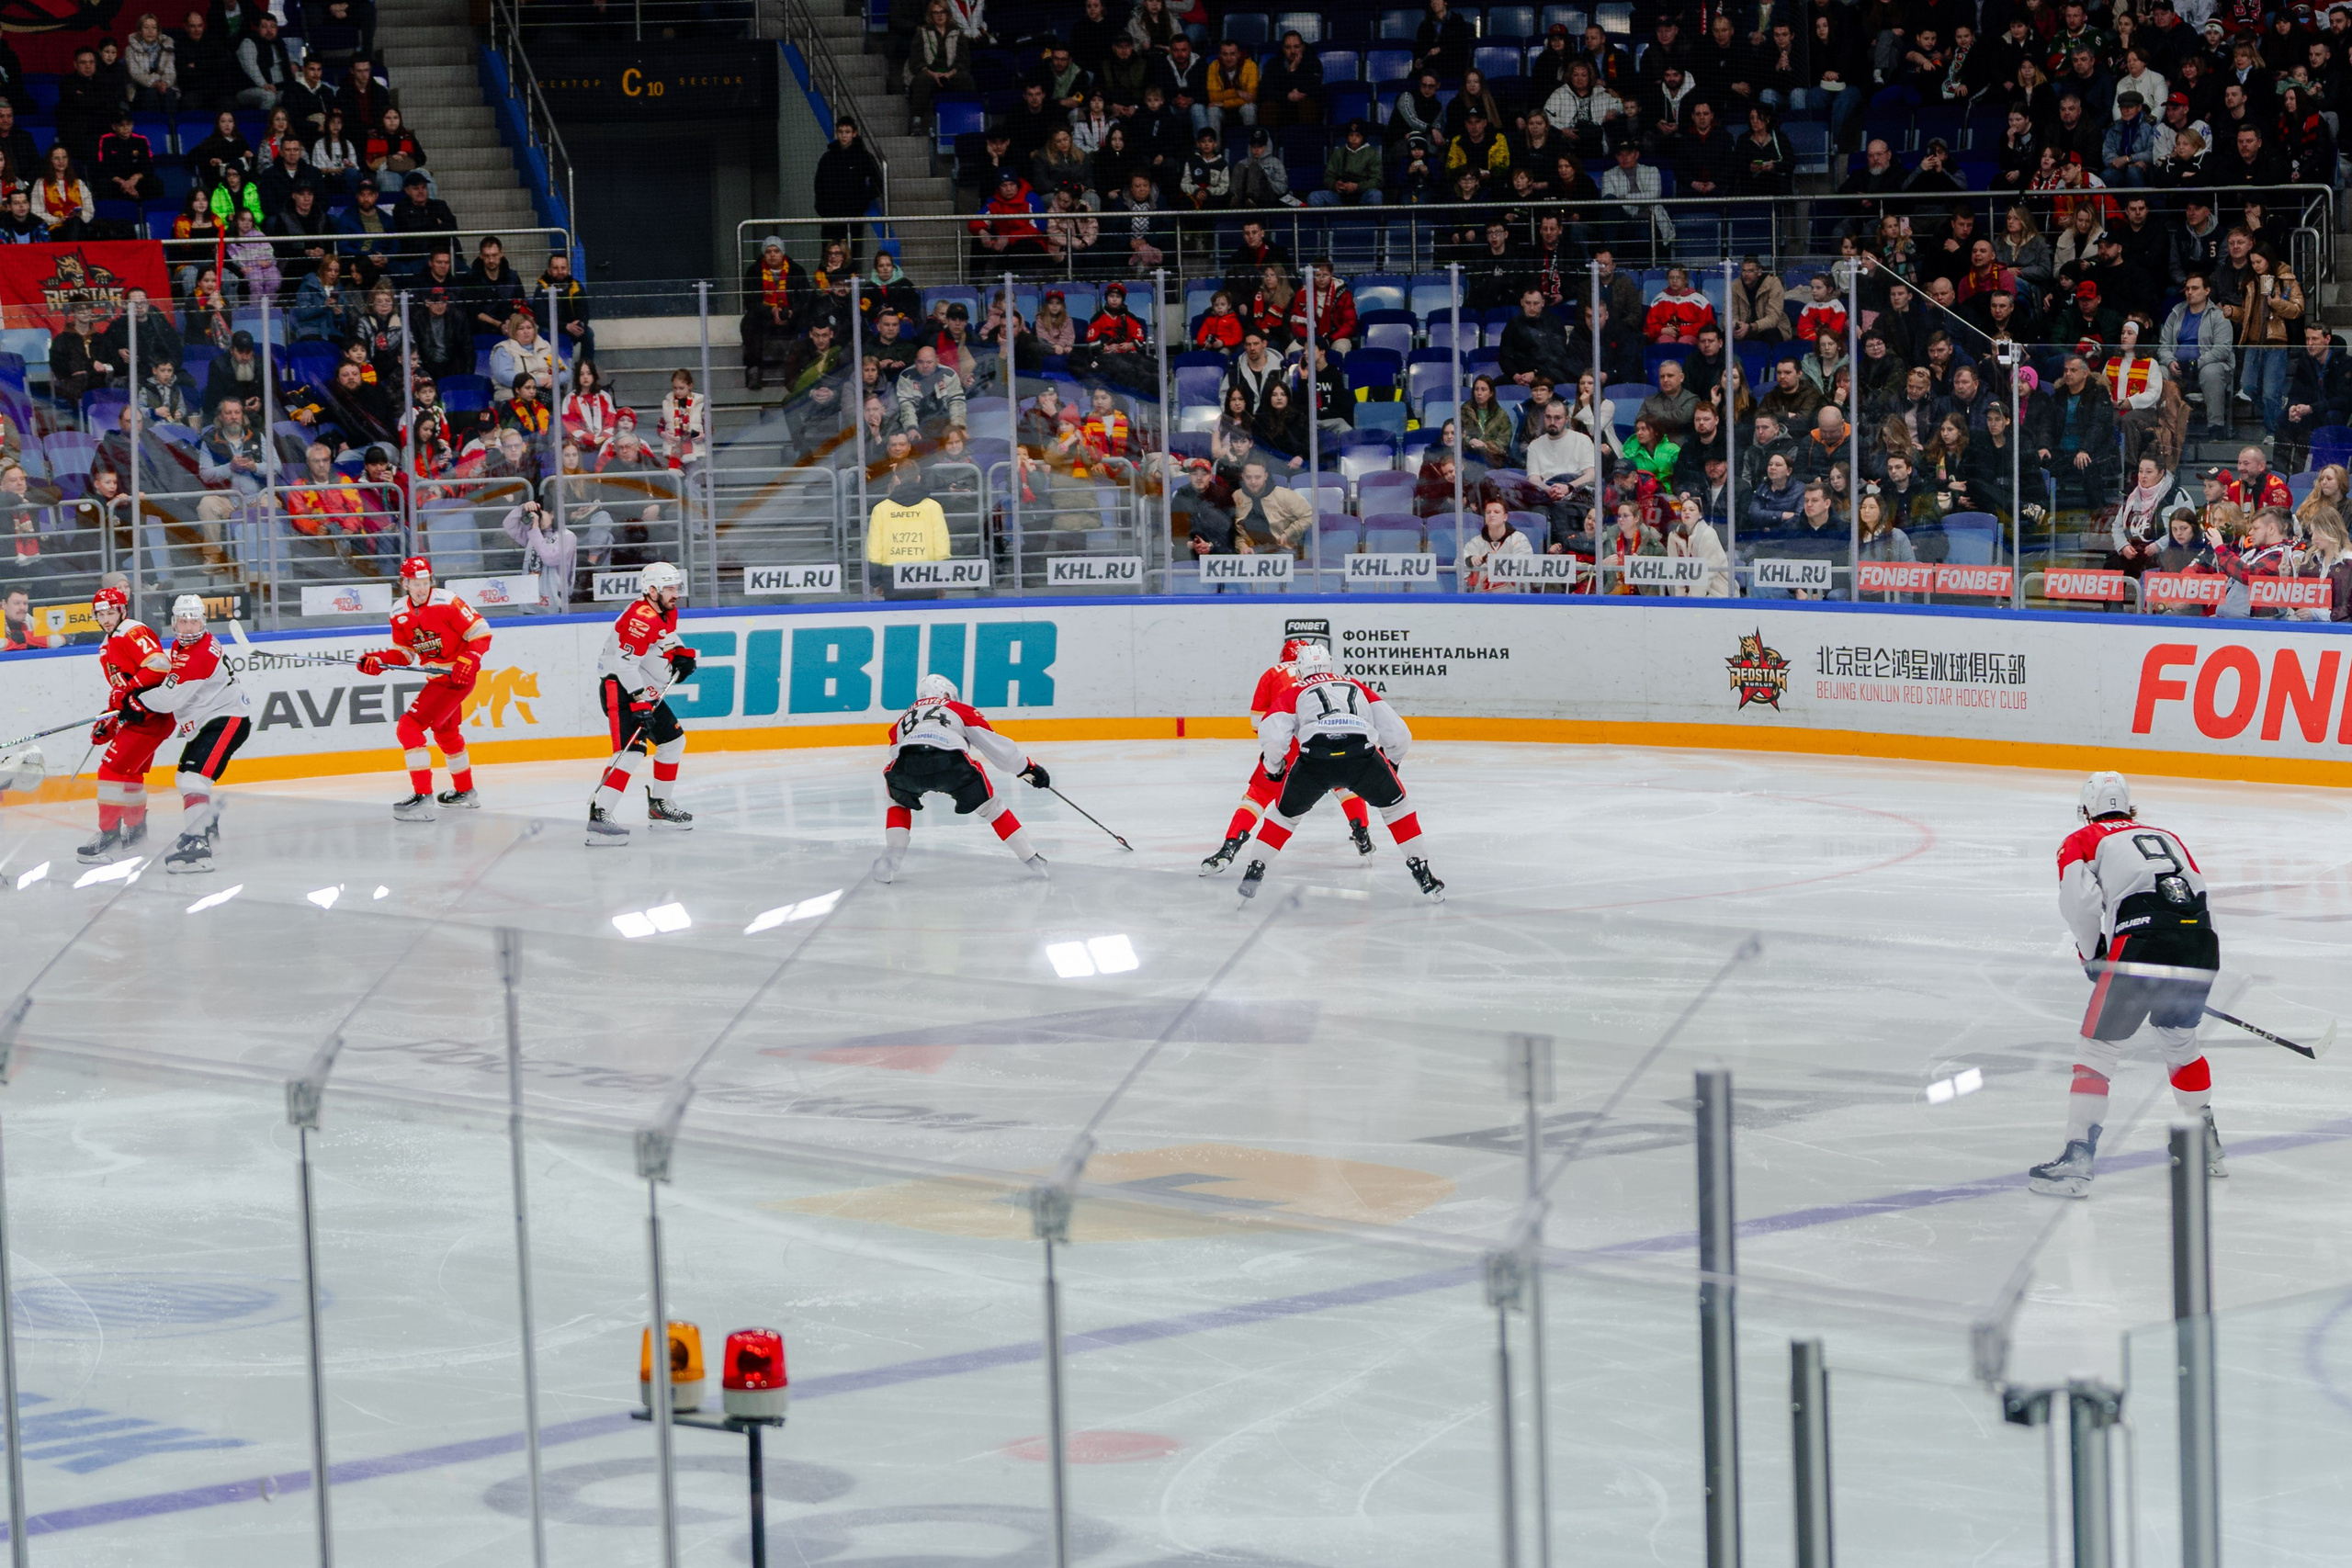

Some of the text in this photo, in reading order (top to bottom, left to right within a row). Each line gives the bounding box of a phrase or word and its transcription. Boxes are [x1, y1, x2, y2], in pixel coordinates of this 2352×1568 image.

[679, 76, 741, 85] SECTOR
[892, 532, 923, 543] K3721
[889, 547, 925, 556] SAFETY
[900, 566, 982, 582] KHL.RU
[1055, 563, 1135, 579] KHL.RU
[1206, 560, 1286, 577] KHL.RU
[1351, 559, 1430, 576] KHL.RU
[1494, 559, 1569, 578] KHL.RU
[1630, 561, 1702, 580] KHL.RU
[1759, 565, 1826, 582] KHL.RU
[752, 570, 833, 588] KHL.RU
[1860, 567, 1932, 588] FONBET
[1937, 569, 2011, 591] FONBET
[2046, 573, 2122, 595] FONBET
[2146, 577, 2225, 599] FONBET
[2250, 581, 2331, 604] FONBET
[1287, 622, 1327, 631] FONBET
[1342, 630, 1410, 641] ФОНБЕТ
[138, 636, 158, 654] 21
[1343, 648, 1510, 659] КОНТИНЕНТАЛЬНАЯ
[665, 621, 1057, 717] SIBUR
[1343, 661, 1447, 676] ХОККЕЙНАЯ
[1816, 645, 2027, 684] 北京昆仑鸿星冰球俱乐部
[1297, 673, 1351, 688] OKULOV
[1726, 666, 1791, 693] REDSTAR
[1306, 682, 1359, 720] 17
[1816, 681, 2027, 709] BEIJING KUNLUN RED STAR HOCKEY CLUB
[2132, 643, 2352, 745] FON
[901, 706, 951, 737] 84
[2132, 834, 2184, 875] 9
[2240, 1021, 2278, 1043] CCM
